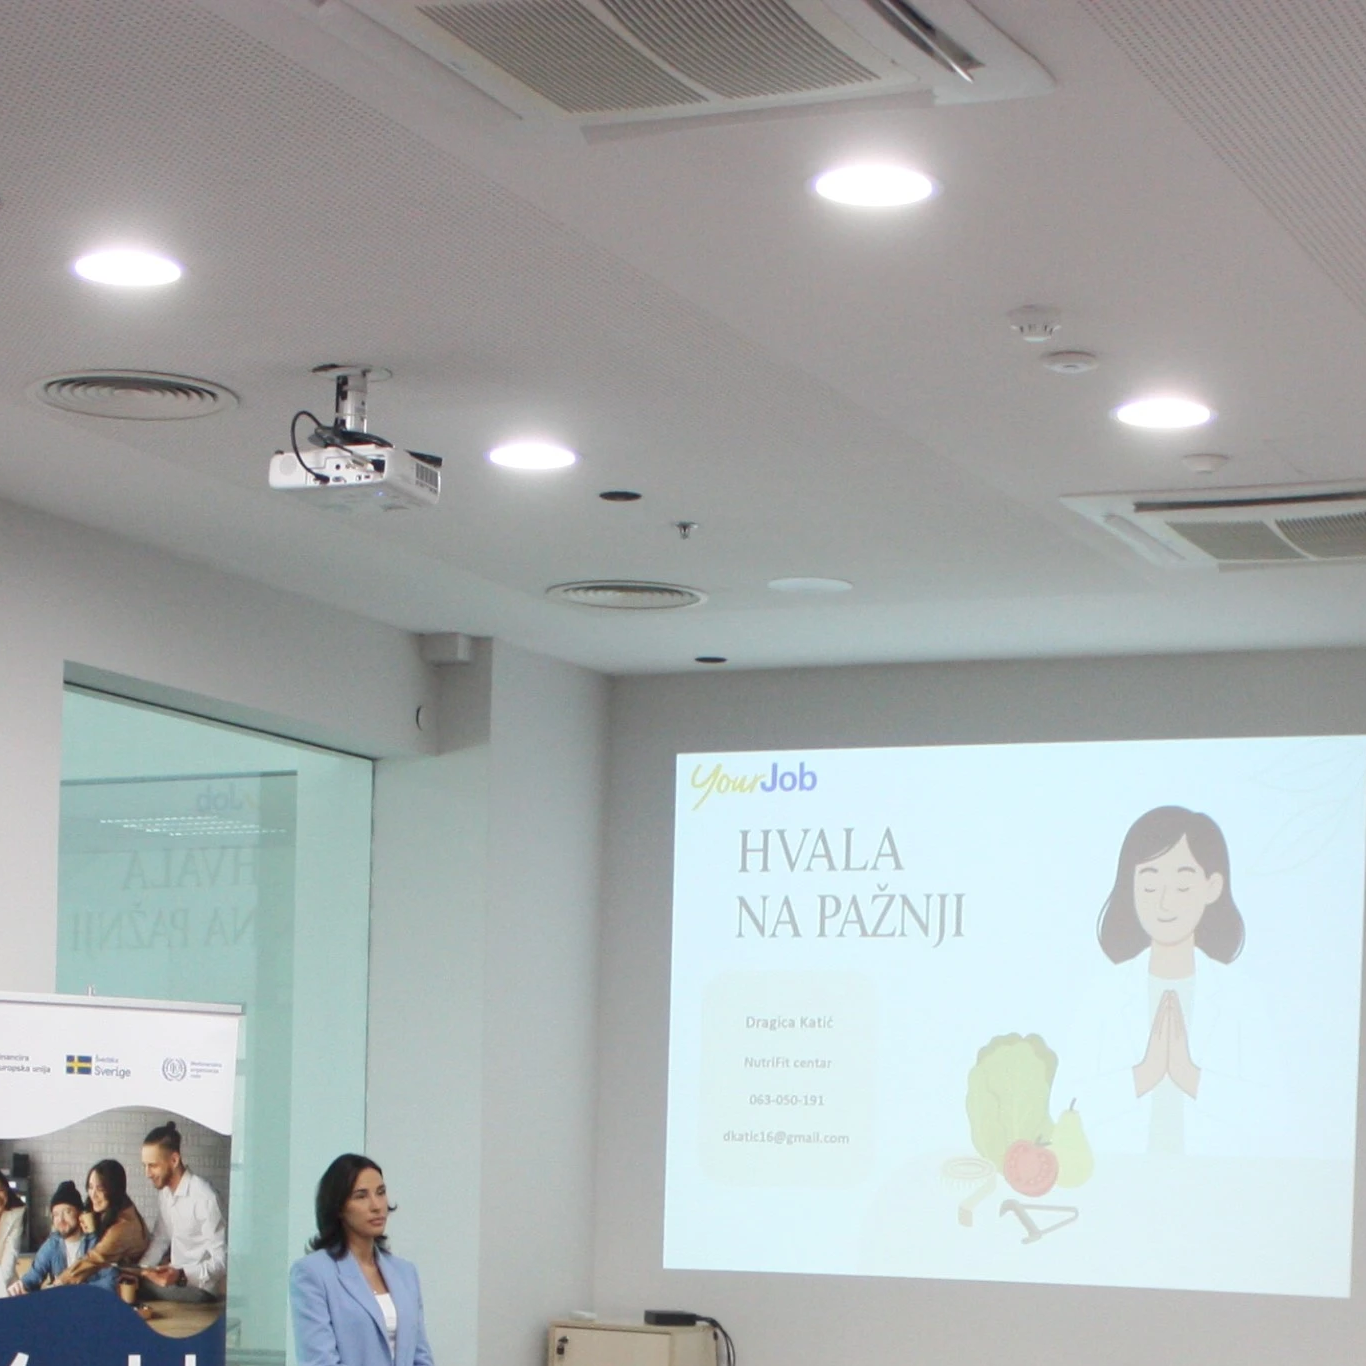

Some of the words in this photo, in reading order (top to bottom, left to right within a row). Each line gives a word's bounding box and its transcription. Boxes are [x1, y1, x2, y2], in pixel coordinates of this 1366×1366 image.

[690, 761, 818, 811] YourJob
[738, 826, 905, 873] HVALA
[735, 894, 802, 938] NA
[816, 882, 966, 948] PAŽNJI
[745, 1015, 795, 1031] Dragica
[800, 1015, 834, 1029] Katić
[94, 1065, 131, 1080] Sverige
[793, 1058, 832, 1069] centar
